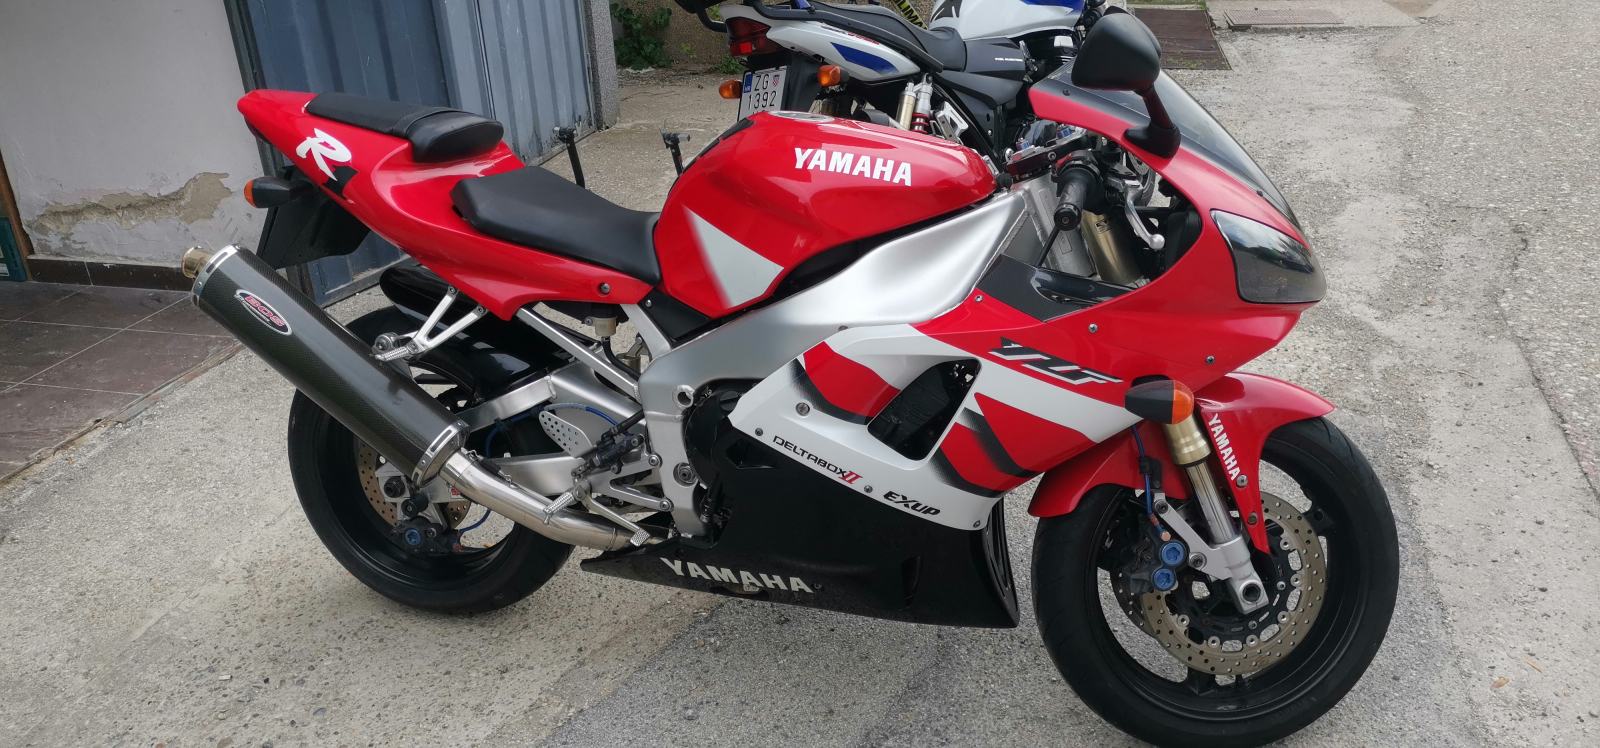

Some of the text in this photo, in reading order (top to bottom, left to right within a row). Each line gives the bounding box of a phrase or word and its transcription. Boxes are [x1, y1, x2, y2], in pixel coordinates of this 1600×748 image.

[754, 74, 769, 91] ZG
[748, 91, 777, 109] 1392
[795, 148, 911, 187] YAMAHA
[1208, 413, 1240, 480] YAMAHA
[883, 491, 940, 516] EXUP
[660, 557, 814, 593] YAMAHA
